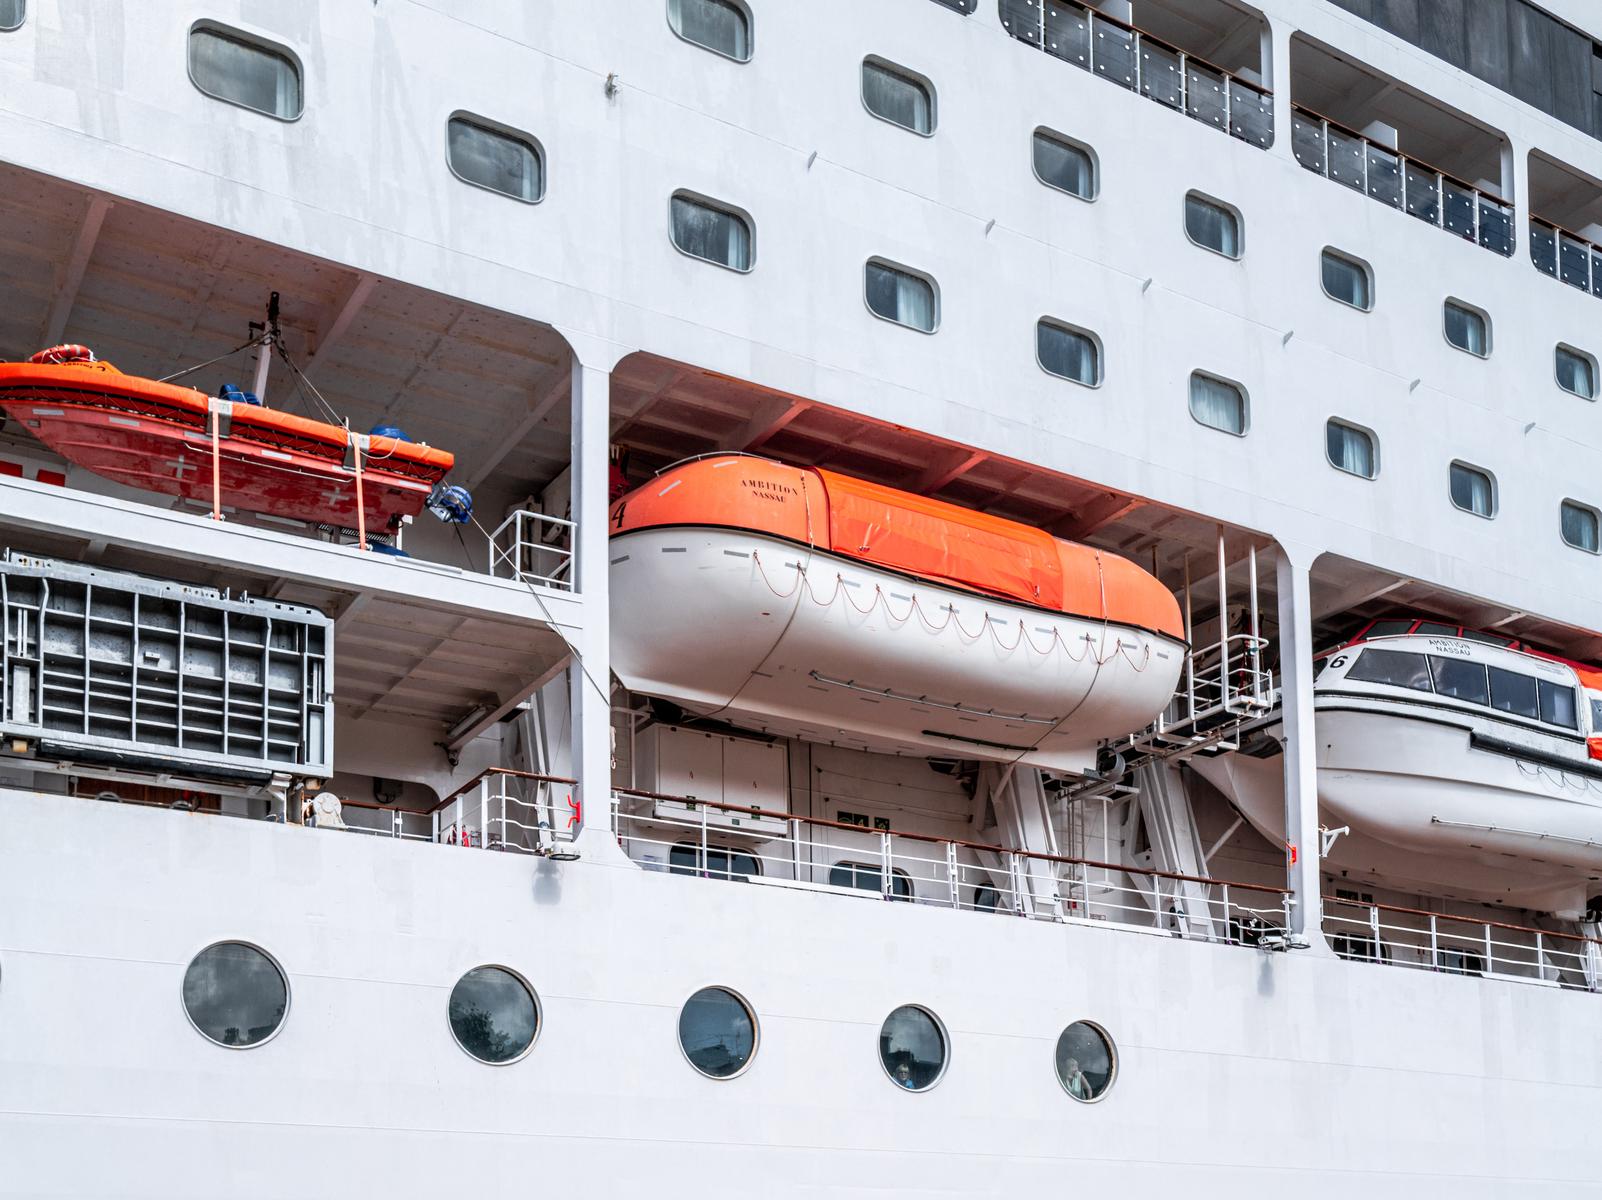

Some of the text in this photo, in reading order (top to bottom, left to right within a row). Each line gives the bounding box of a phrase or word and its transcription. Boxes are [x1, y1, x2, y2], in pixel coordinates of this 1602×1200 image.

[741, 479, 799, 496] AMBITION
[751, 490, 787, 503] NASSAU
[611, 501, 627, 529] 4
[1428, 639, 1471, 650] AMBITION
[1436, 646, 1471, 656] NASSAU
[1329, 655, 1348, 669] 6
